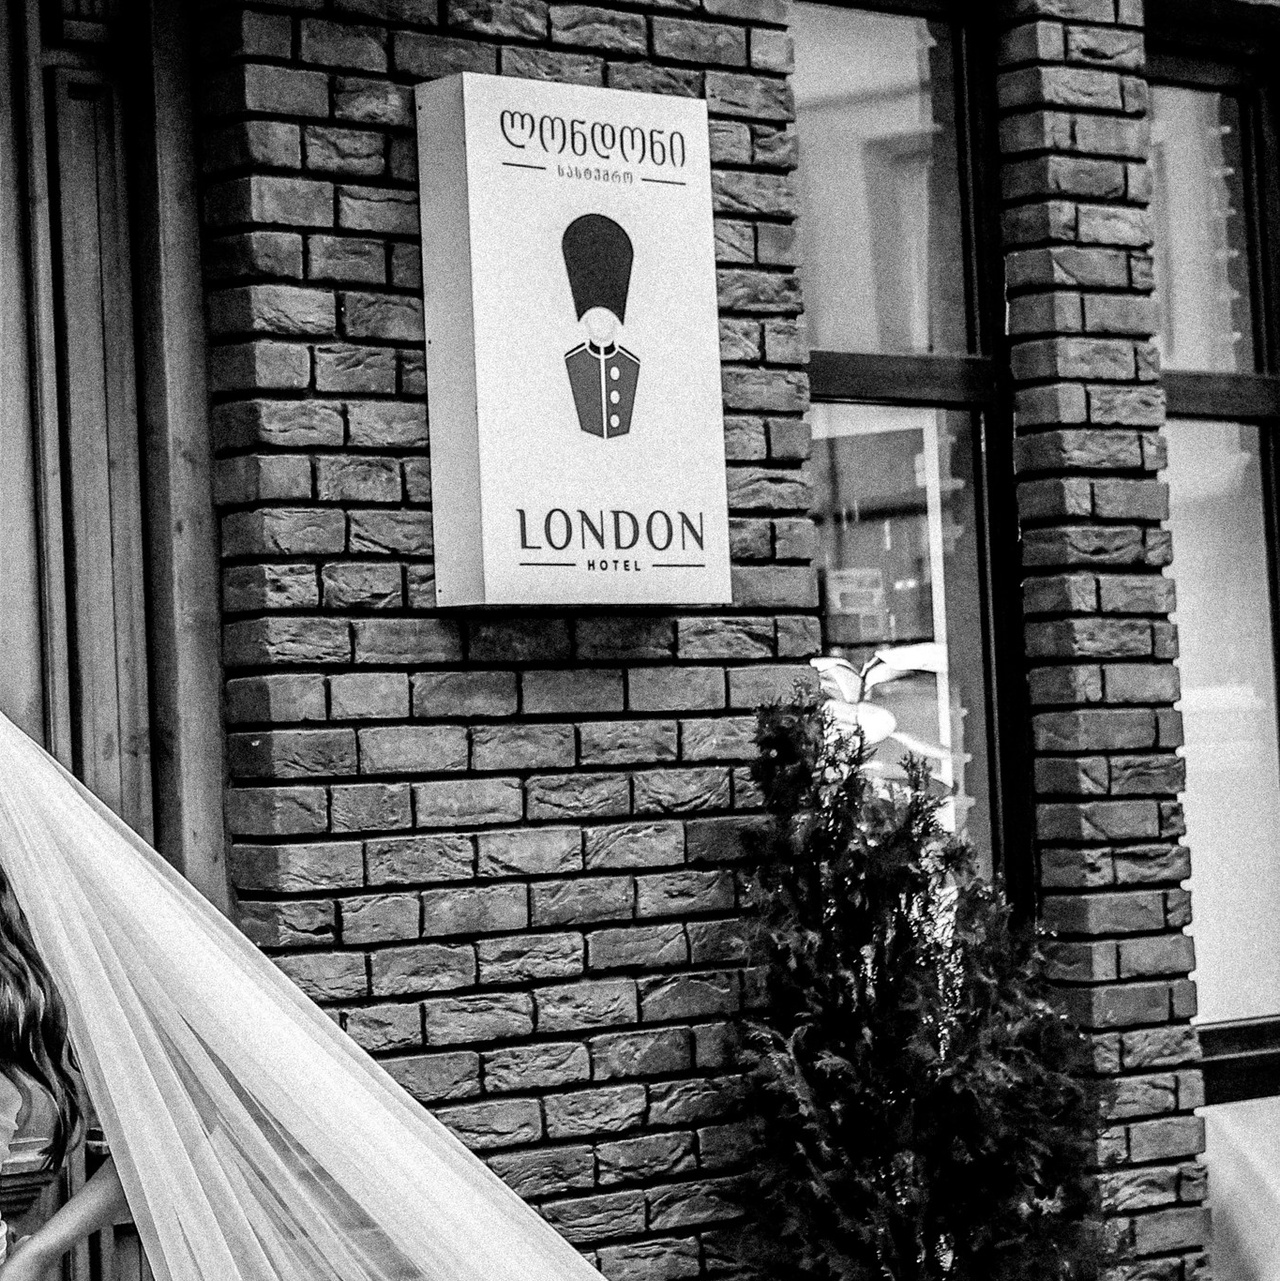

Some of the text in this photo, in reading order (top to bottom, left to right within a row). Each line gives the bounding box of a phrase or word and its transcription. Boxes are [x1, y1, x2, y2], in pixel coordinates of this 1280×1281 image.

[500, 110, 686, 167] ლონდონი
[516, 508, 705, 551] LONDON
[587, 560, 641, 572] HOTEL
